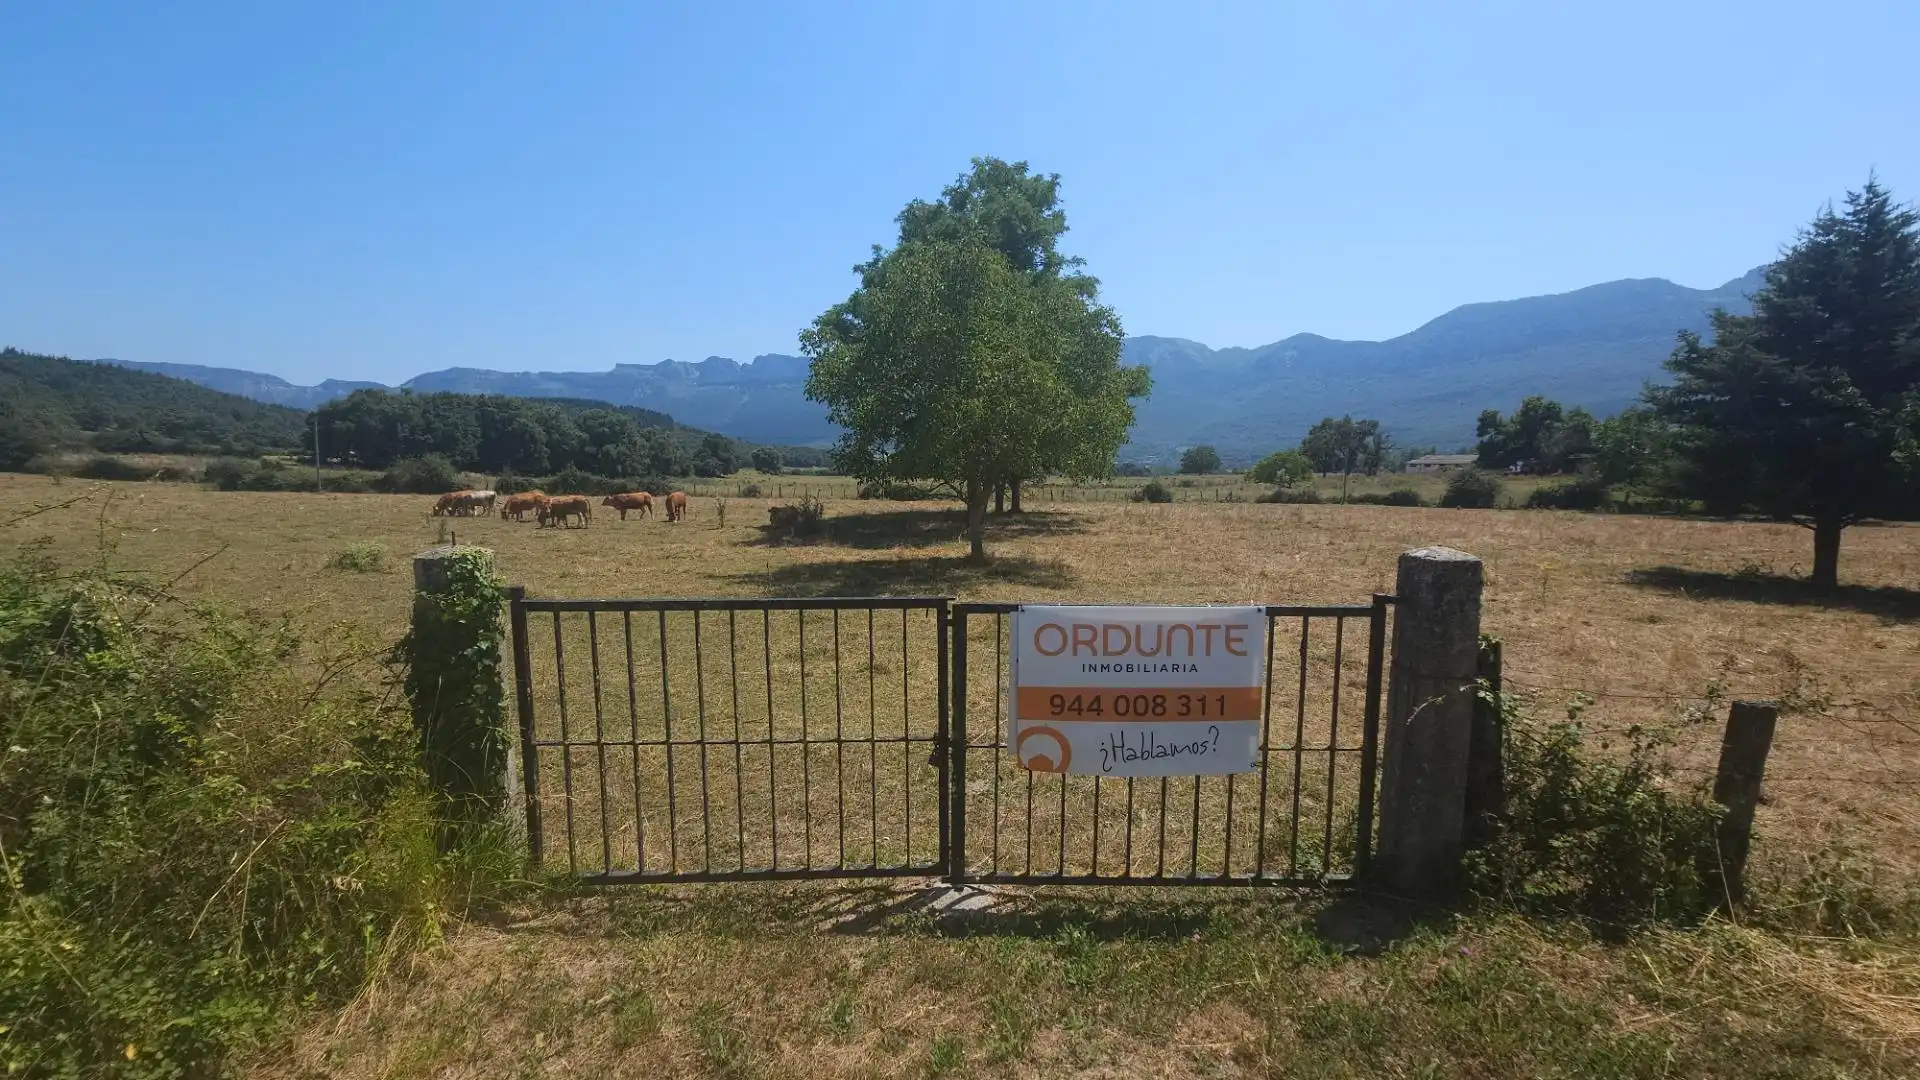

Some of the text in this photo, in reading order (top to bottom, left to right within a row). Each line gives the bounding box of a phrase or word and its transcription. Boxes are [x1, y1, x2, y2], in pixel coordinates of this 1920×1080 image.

[1033, 623, 1248, 658] ORDUNTE
[1082, 663, 1199, 673] INMOBILIARIA
[1049, 694, 1226, 717] 944 008 311
[1099, 725, 1220, 772] ¿Hablamos?
